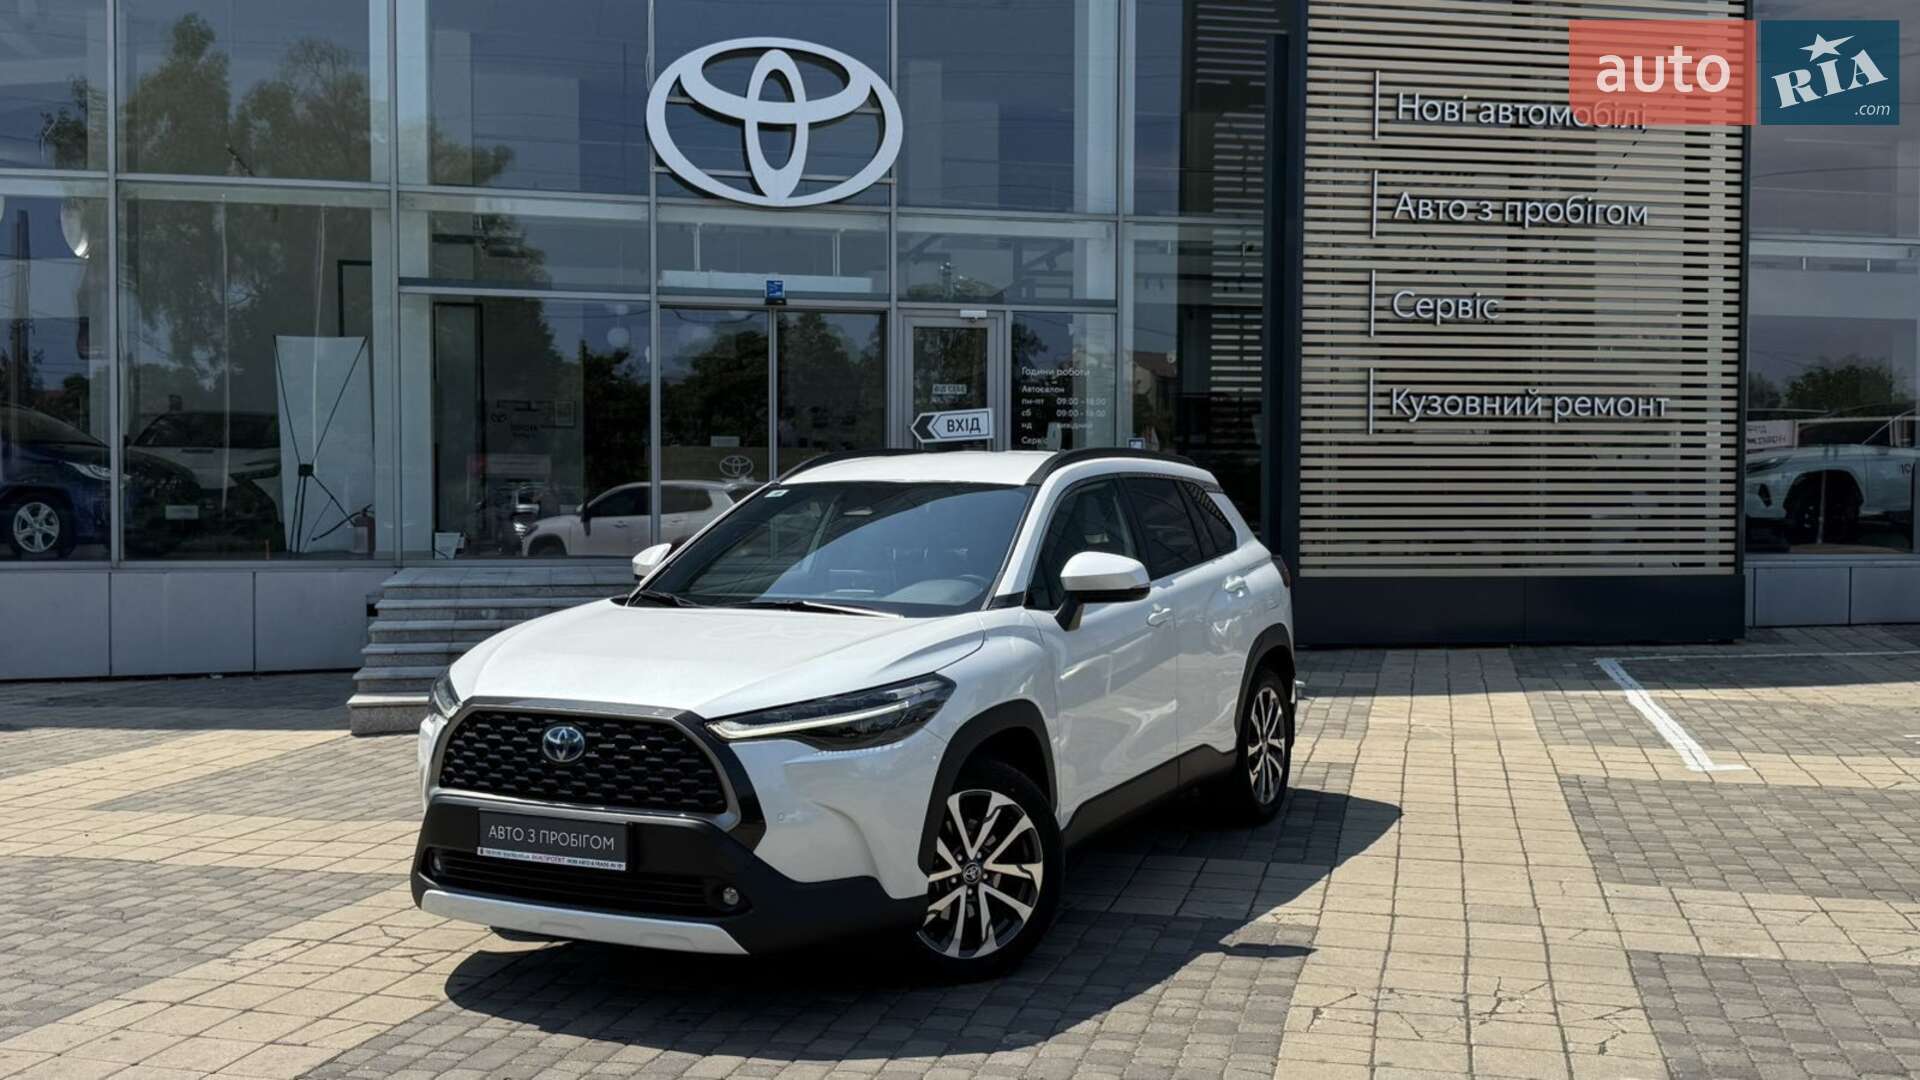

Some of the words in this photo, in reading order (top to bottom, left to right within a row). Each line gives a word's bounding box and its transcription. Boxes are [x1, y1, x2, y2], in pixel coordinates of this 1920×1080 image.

[1398, 92, 1468, 122] Нові
[1478, 99, 1649, 129] автомобілі
[1393, 191, 1468, 221] Авто
[1477, 199, 1493, 221] з
[1504, 194, 1649, 228] пробігом
[1392, 290, 1500, 325] Сервіс
[1021, 366, 1055, 378] Години
[1056, 366, 1090, 378] роботи
[1021, 385, 1065, 393] Автосалон
[1390, 386, 1543, 423] Кузовний
[1553, 395, 1670, 424] ремонт
[946, 417, 981, 434] ВХІД
[488, 825, 525, 842] АВТО
[528, 828, 536, 843] З
[539, 829, 615, 851] ПРОБІГОМ
